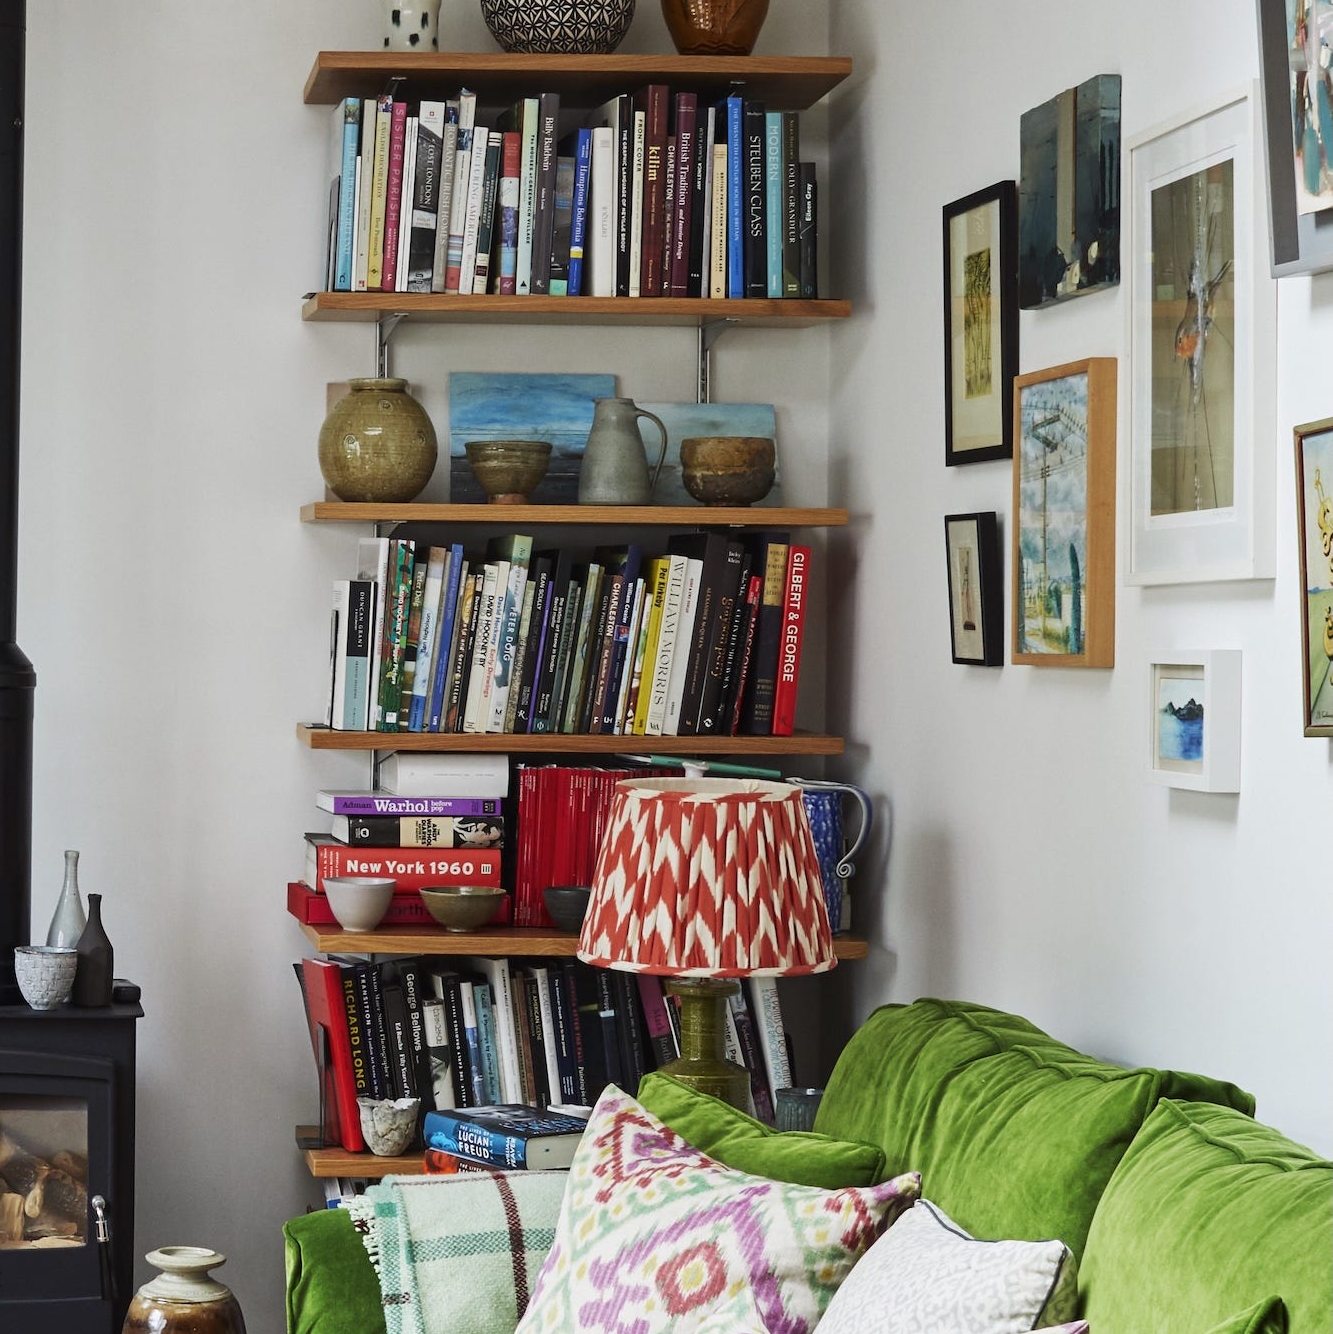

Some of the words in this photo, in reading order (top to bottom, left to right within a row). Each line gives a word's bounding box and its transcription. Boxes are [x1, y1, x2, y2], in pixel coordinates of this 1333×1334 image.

[392, 109, 403, 161] SISTER
[542, 117, 554, 136] Billy
[442, 126, 454, 180] ROMANTIC
[542, 137, 553, 171] Baldwin
[680, 132, 690, 162] British
[769, 125, 778, 181] MODERN
[648, 146, 660, 181] kilim
[666, 146, 675, 199] CHARLESTON
[750, 136, 761, 191] STEUBEN
[389, 169, 400, 222] PARISH
[424, 167, 433, 205] LONDON
[442, 182, 450, 209] IRISH
[577, 165, 588, 206] Hamptons
[678, 165, 689, 205] Tradition
[439, 211, 448, 245] HOMES
[574, 208, 584, 242] Bohemia
[750, 195, 762, 237] GLASS
[415, 571, 424, 590] Peter
[659, 567, 668, 580] Per
[790, 552, 805, 610] GILBERT
[357, 591, 365, 621] DUNCAN
[413, 590, 422, 607] Doig
[486, 595, 495, 617] DAVID
[496, 596, 505, 615] David
[536, 587, 545, 611] SCULLY
[625, 583, 634, 603] William
[654, 581, 666, 608] Kirkeby
[664, 562, 684, 634] WILLIAM
[506, 606, 518, 632] PETER
[605, 582, 621, 637] CHARLESTON
[622, 604, 630, 624] Crozier
[788, 612, 799, 621] &
[479, 619, 491, 656] HOCKNEY
[490, 617, 501, 645] Hockney
[479, 658, 486, 668] BY
[487, 649, 496, 666] Early
[503, 636, 513, 661] DOIG
[782, 625, 797, 683] GEORGE
[655, 639, 673, 706] MORRIS
[342, 801, 372, 809] Adman
[374, 799, 429, 812] Warhol
[346, 860, 381, 873] New
[385, 860, 424, 874] York
[429, 862, 474, 875] 1960
[360, 974, 371, 1026] TRANSITION
[405, 973, 417, 1009] George
[411, 1012, 421, 1051] Bellows
[344, 980, 360, 1046] RICHARD
[352, 1050, 365, 1089] LONG
[458, 1130, 489, 1147] LUCIAN
[459, 1141, 490, 1159] FREUD
